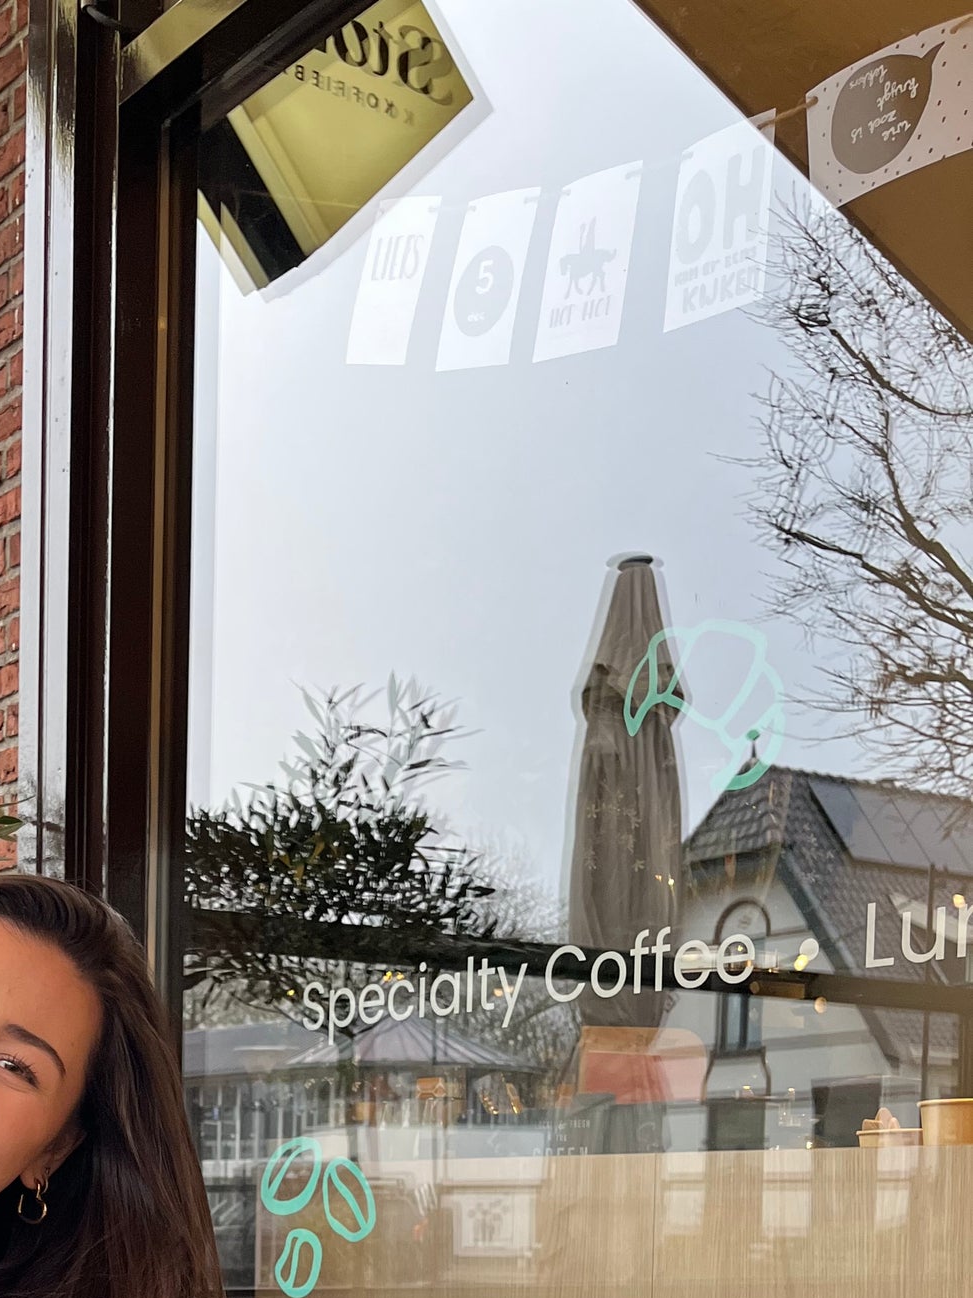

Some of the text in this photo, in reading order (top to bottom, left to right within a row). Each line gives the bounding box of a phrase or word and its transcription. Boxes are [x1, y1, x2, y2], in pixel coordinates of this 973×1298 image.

[677, 144, 766, 265] OH
[475, 259, 494, 295] 5
[302, 956, 529, 1046] Specialty
[545, 926, 756, 1003] Coffee
